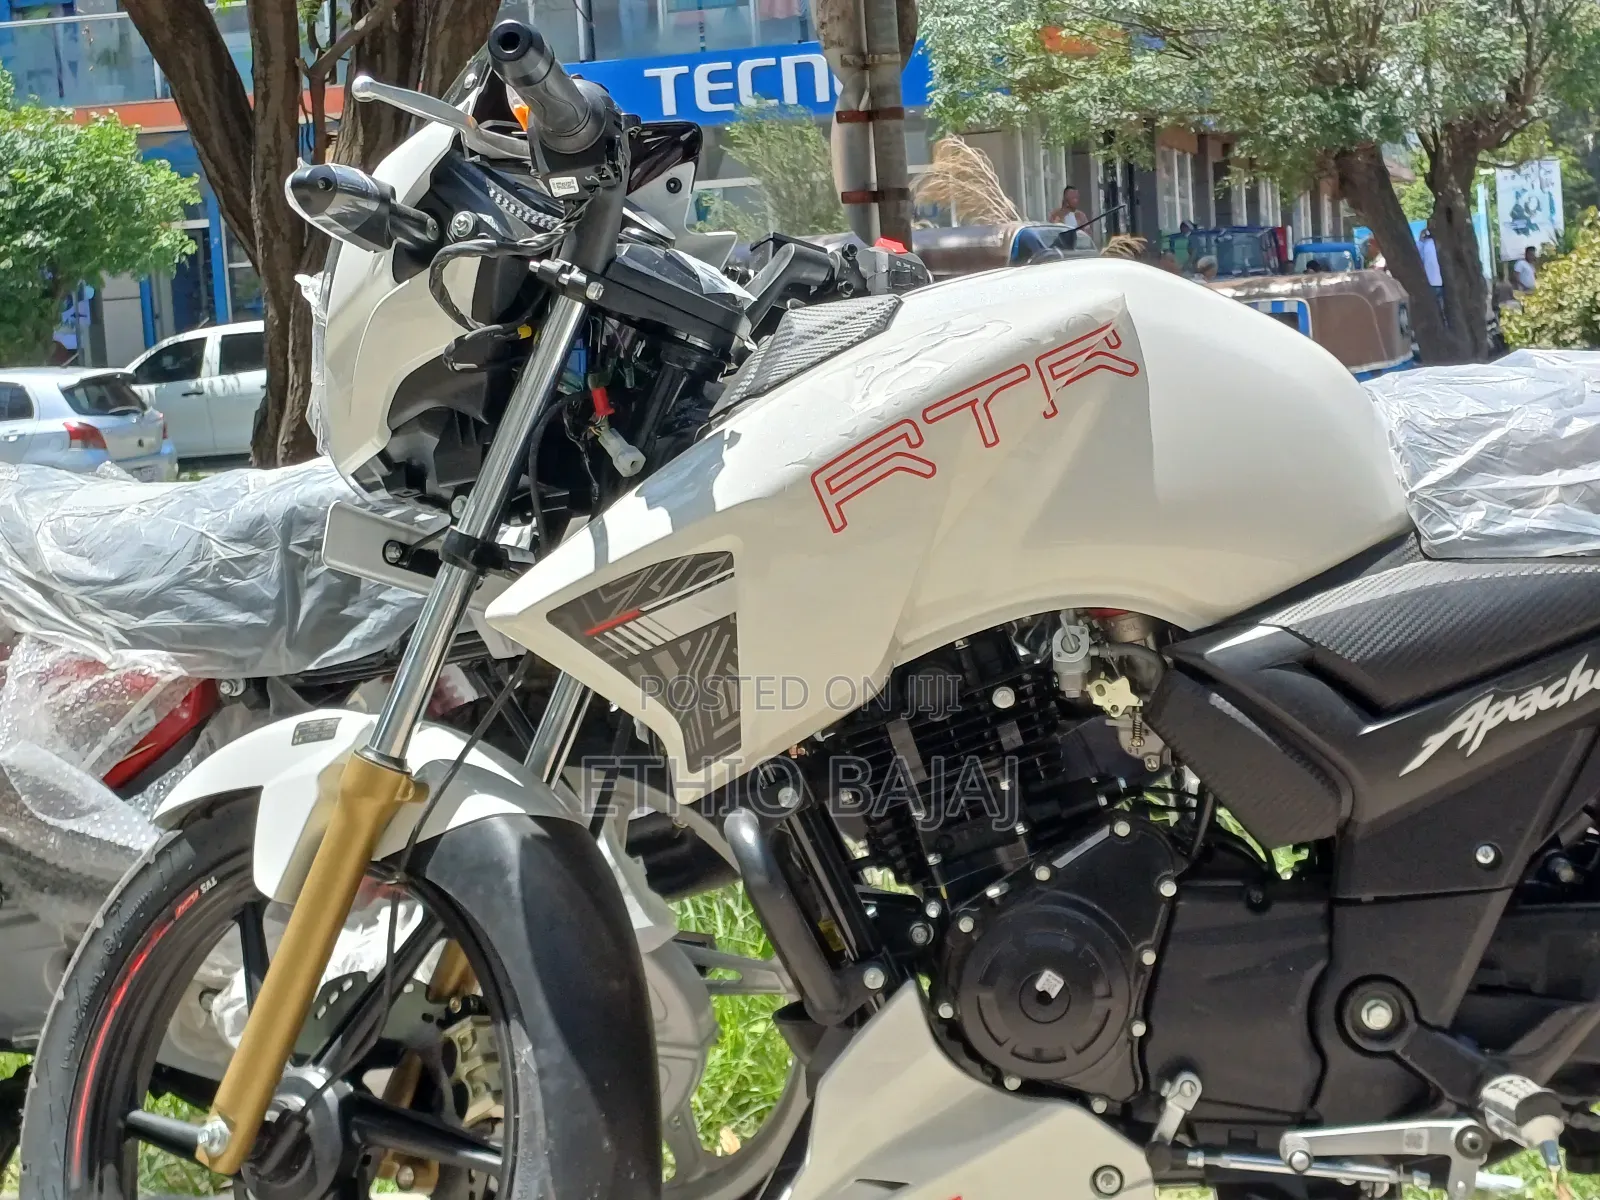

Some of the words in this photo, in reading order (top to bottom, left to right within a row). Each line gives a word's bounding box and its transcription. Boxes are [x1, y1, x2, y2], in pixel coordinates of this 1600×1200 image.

[643, 53, 844, 116] TECN
[811, 322, 1140, 534] RTR
[199, 875, 218, 895] TVS
